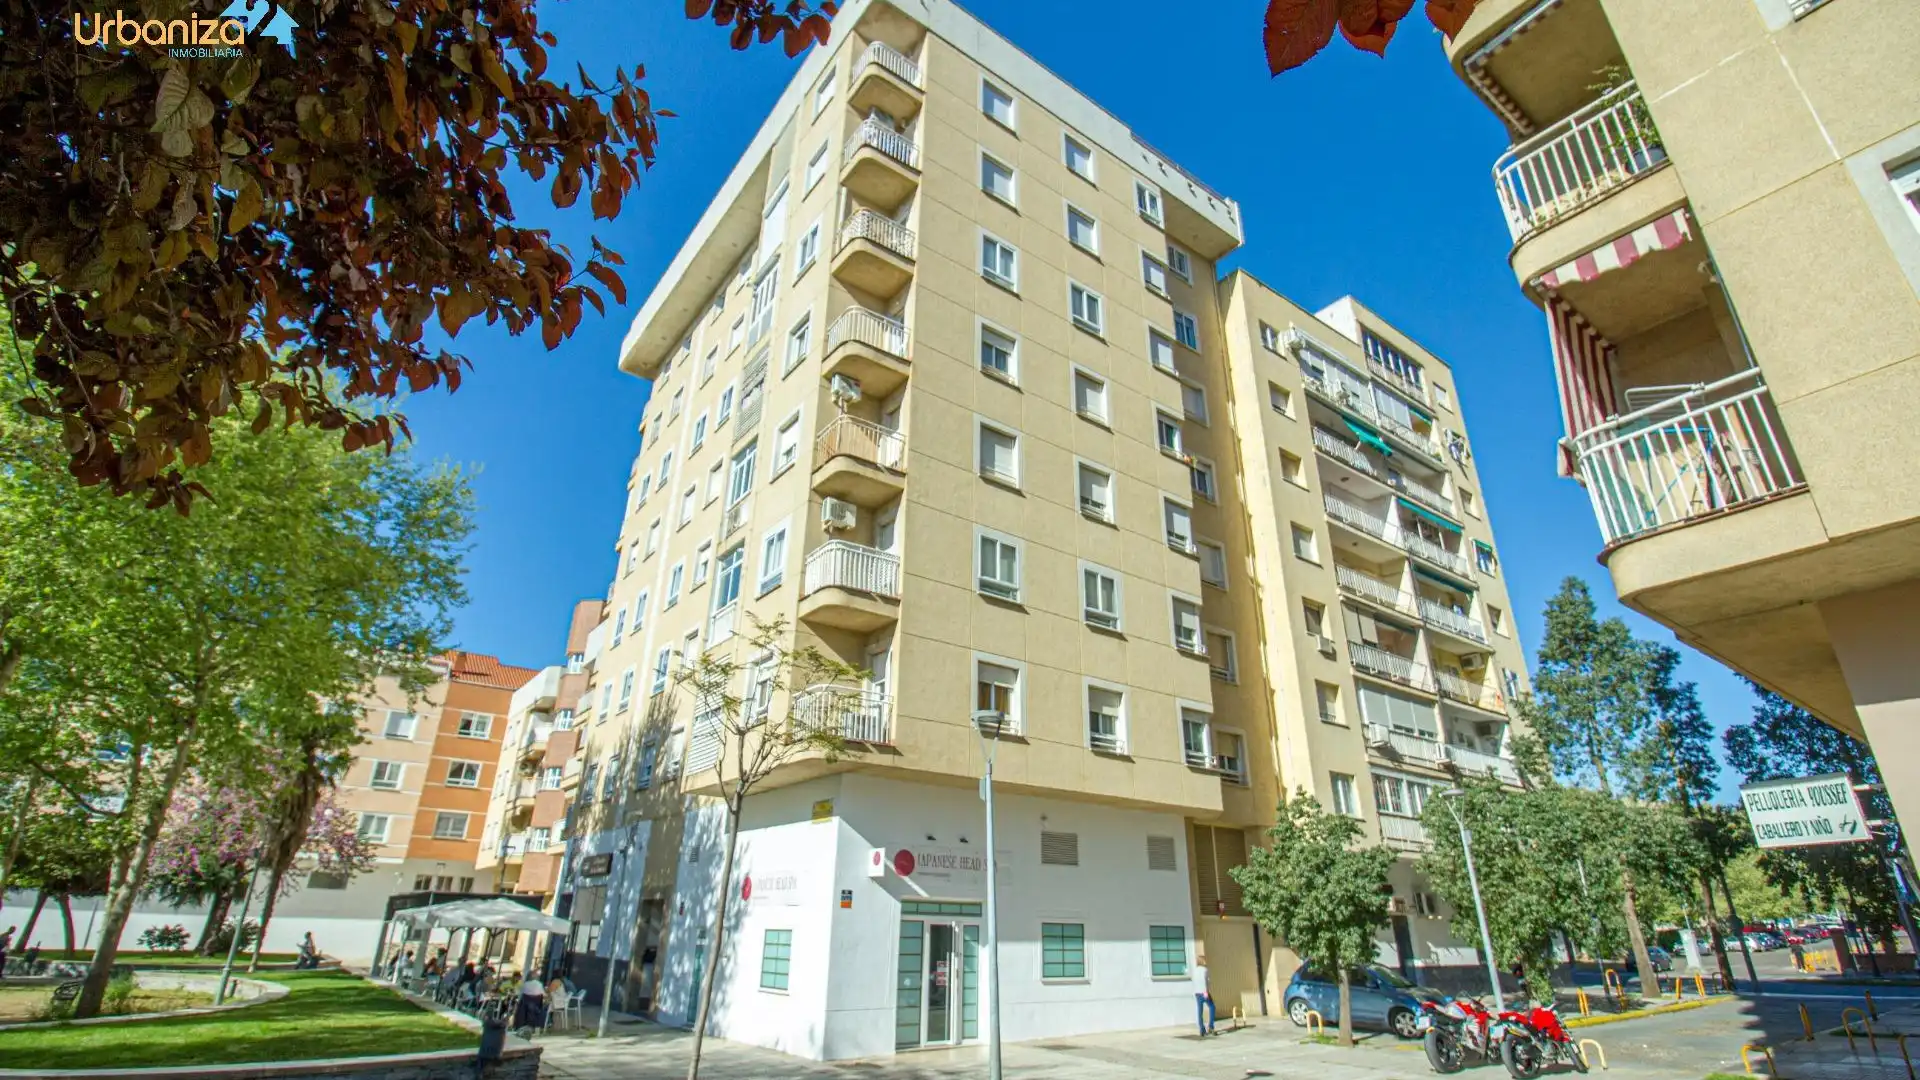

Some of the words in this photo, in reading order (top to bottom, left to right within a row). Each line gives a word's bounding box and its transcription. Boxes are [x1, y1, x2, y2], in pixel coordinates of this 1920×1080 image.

[1807, 782, 1848, 808] YOUSSEF
[1755, 819, 1803, 840] CABALLERO
[1802, 819, 1811, 835] Y
[1811, 815, 1834, 835] NIÑO
[959, 856, 981, 871] HEAD
